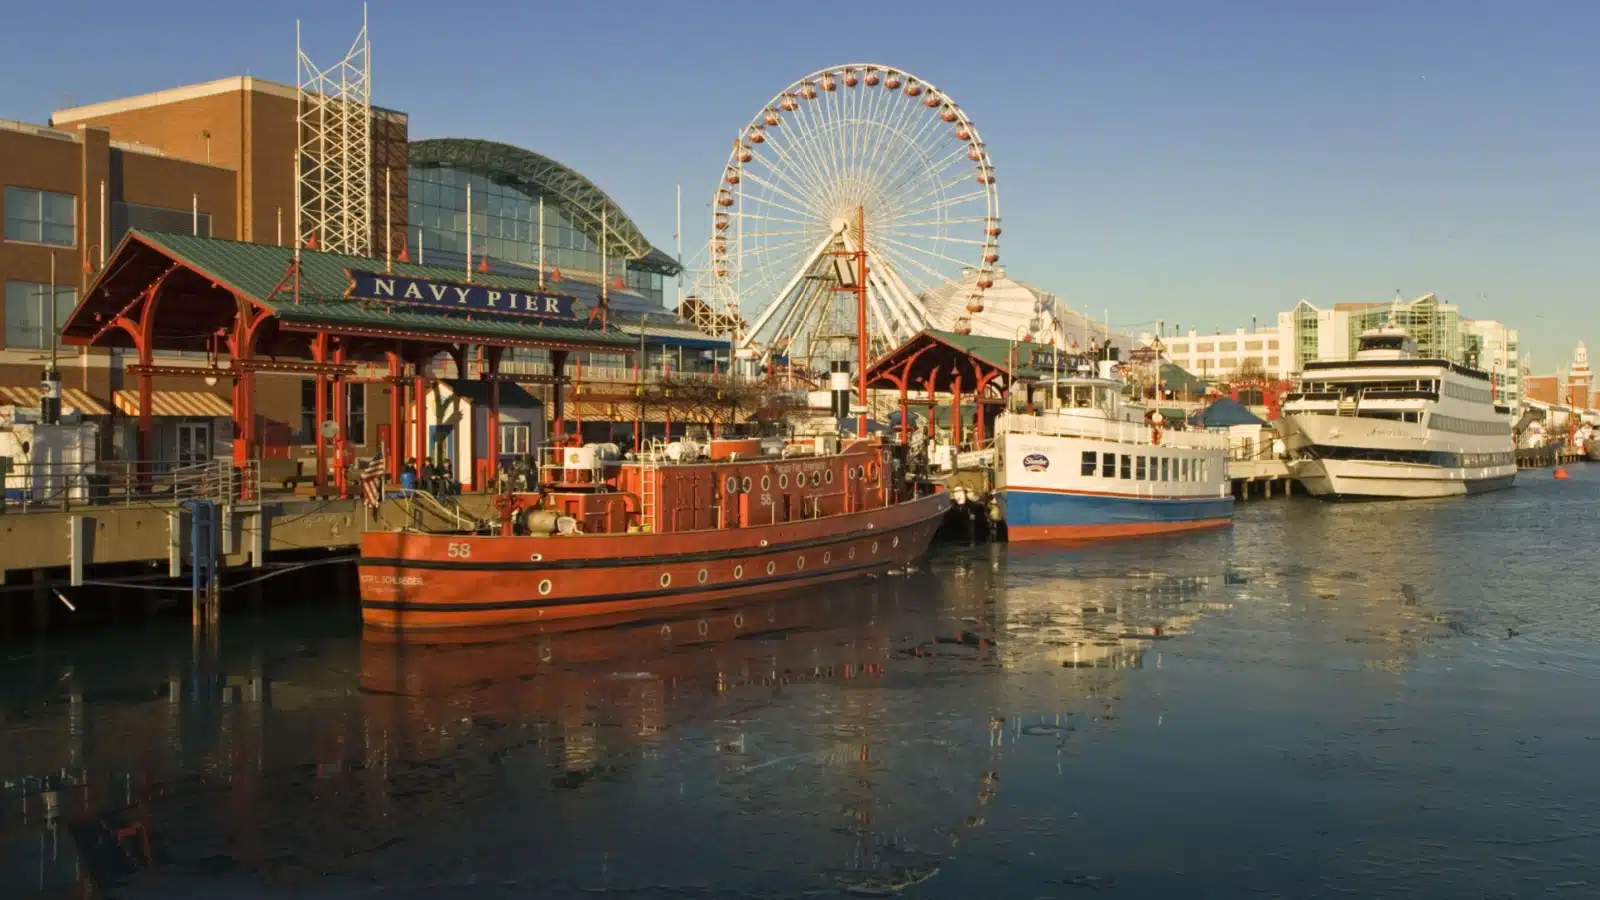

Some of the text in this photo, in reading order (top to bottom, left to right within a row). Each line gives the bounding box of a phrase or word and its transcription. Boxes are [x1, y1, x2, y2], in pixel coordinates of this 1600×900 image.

[373, 278, 561, 313] NAVY PIER
[1038, 354, 1065, 366] NA
[448, 542, 471, 558] 58
